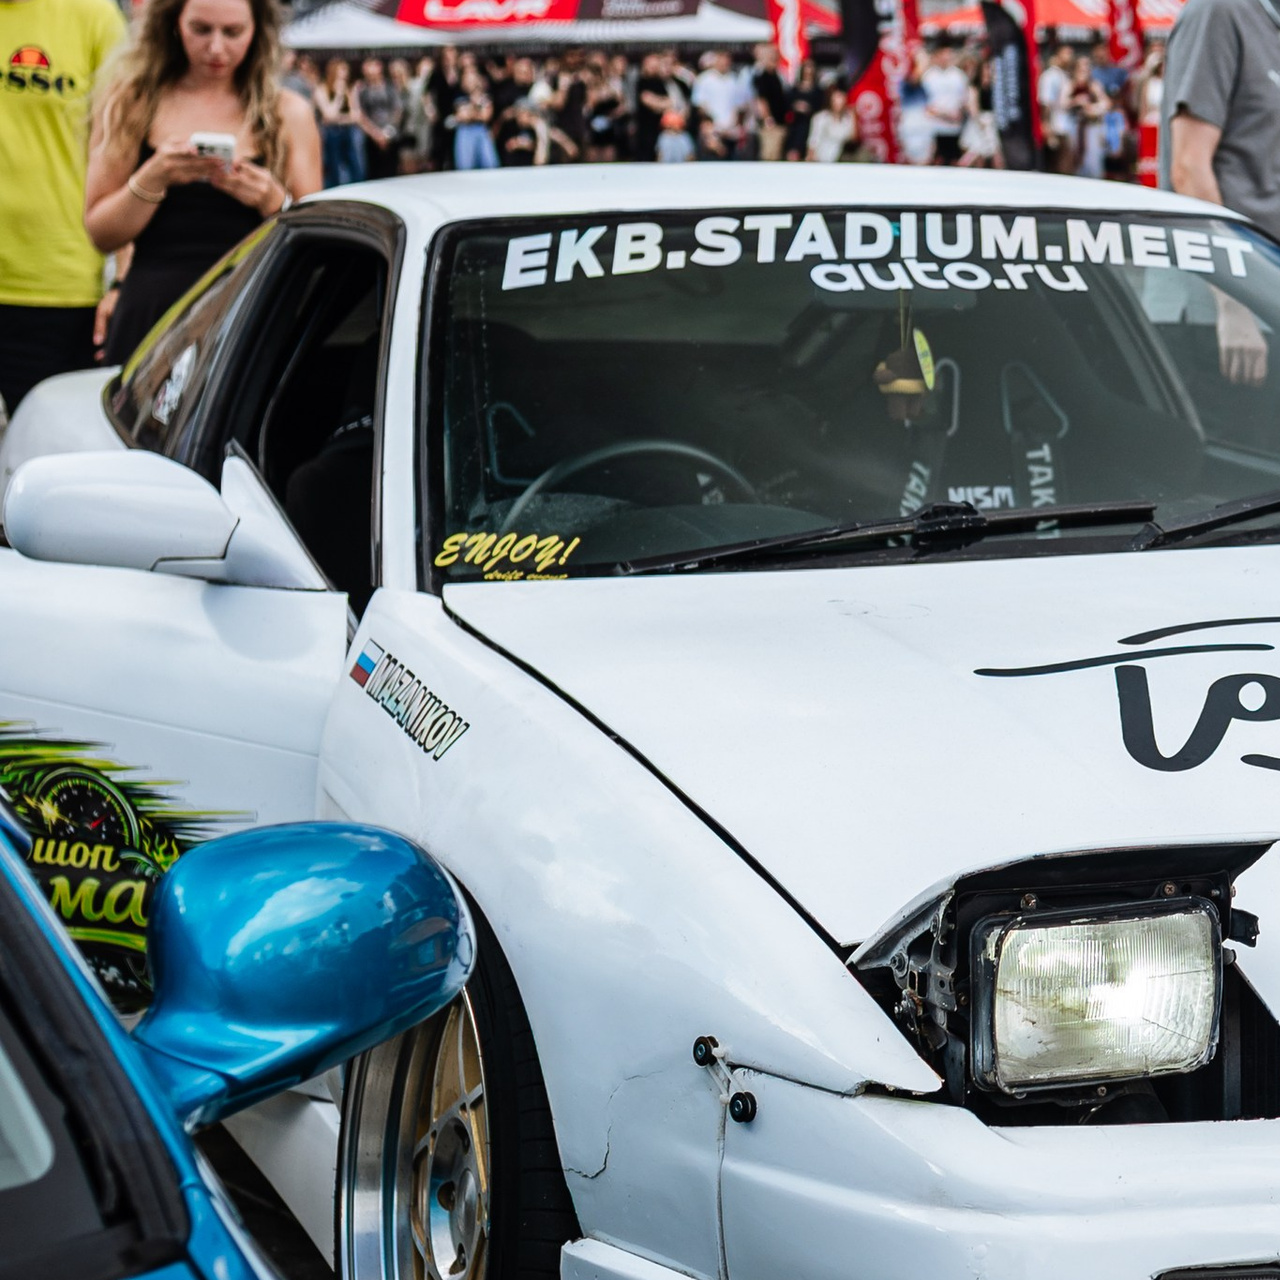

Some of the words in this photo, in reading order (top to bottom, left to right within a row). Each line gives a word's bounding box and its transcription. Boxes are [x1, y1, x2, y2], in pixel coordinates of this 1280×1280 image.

[501, 211, 1254, 291] EKB.STADIUM.MEET
[809, 257, 1089, 293] auto.ru
[434, 532, 581, 572] ENJOY!
[366, 653, 470, 761] MAZANIKOV
